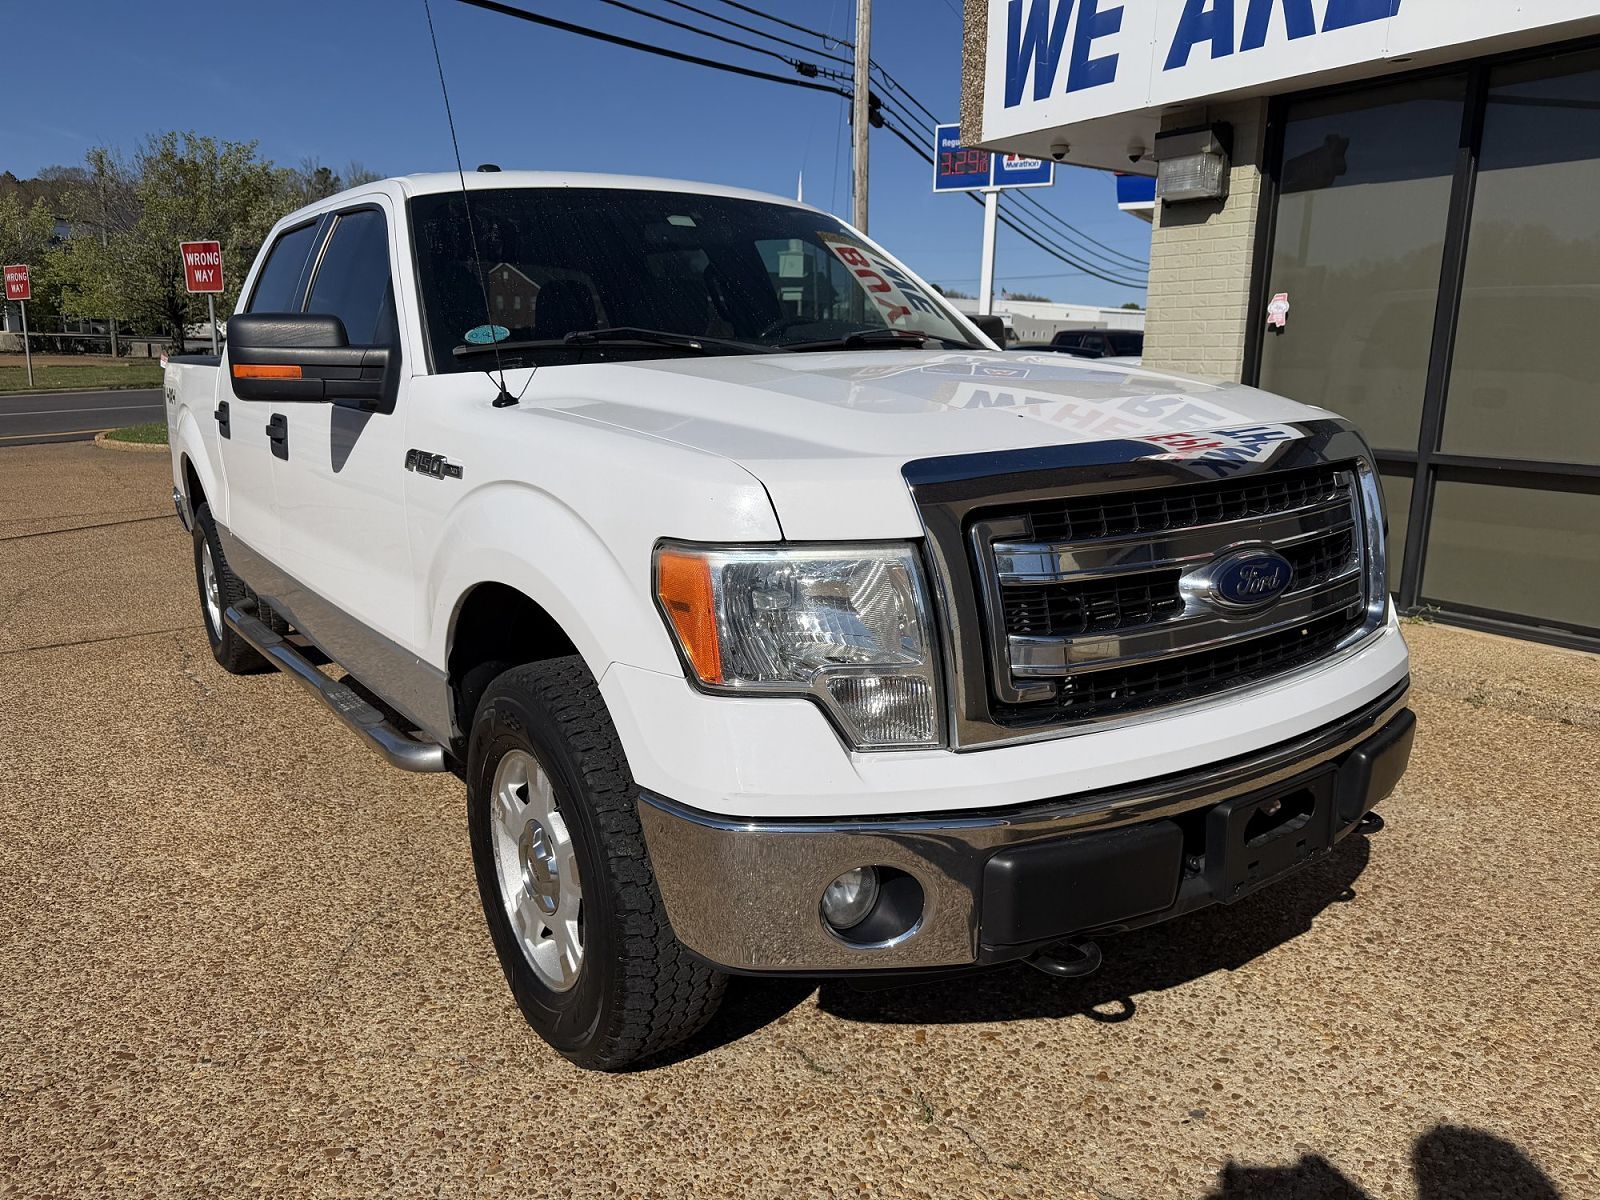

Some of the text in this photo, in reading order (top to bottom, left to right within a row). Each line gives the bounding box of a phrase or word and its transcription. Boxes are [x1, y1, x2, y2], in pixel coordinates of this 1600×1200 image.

[1003, 0, 1125, 109] WE
[1005, 158, 1040, 169] Marathon
[186, 251, 219, 266] WRONG
[5, 272, 27, 282] WRONG
[194, 269, 214, 283] WAY
[10, 283, 24, 293] WAY
[1237, 563, 1281, 595] Ford
